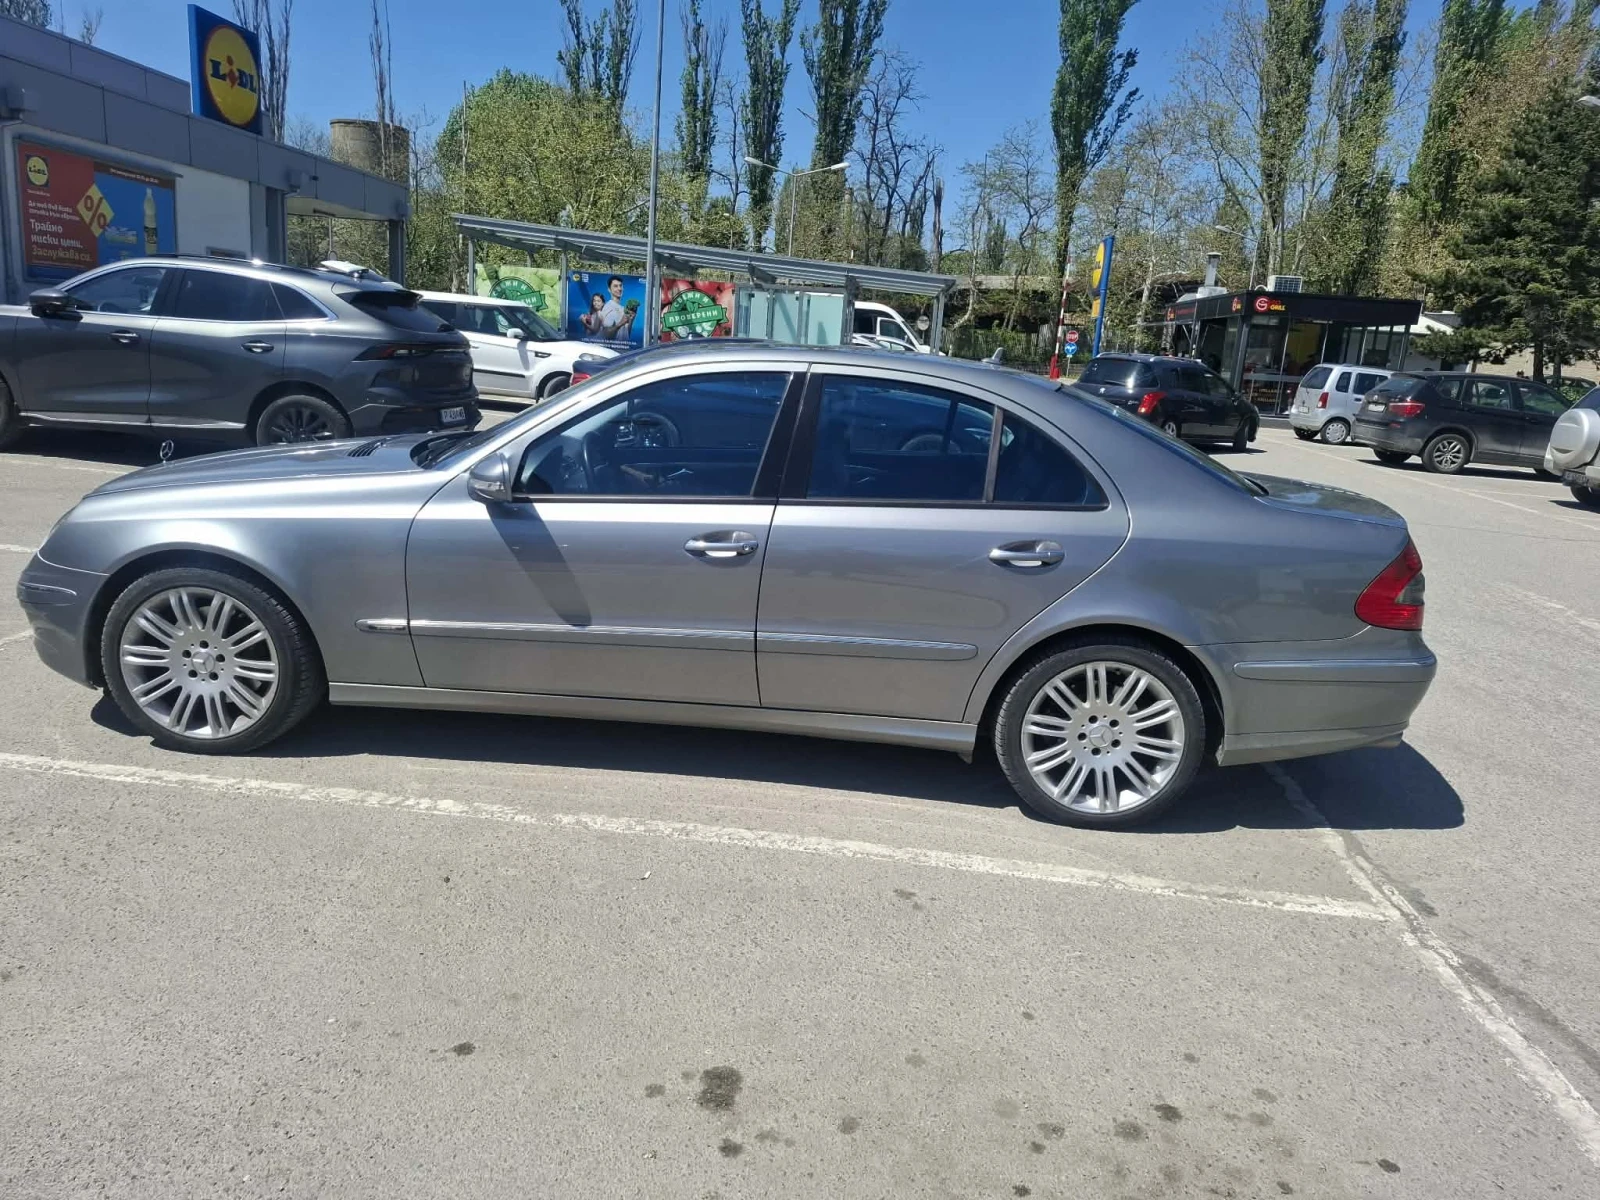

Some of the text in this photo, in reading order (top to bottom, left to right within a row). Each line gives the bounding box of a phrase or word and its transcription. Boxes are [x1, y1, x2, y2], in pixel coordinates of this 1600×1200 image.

[29, 219, 63, 234] Трайно
[31, 234, 83, 249] ниски цени.
[32, 244, 80, 260] Заслужава
[674, 291, 701, 308] СВЕЖИ
[669, 310, 718, 323] ПРОВЕРЕНИ
